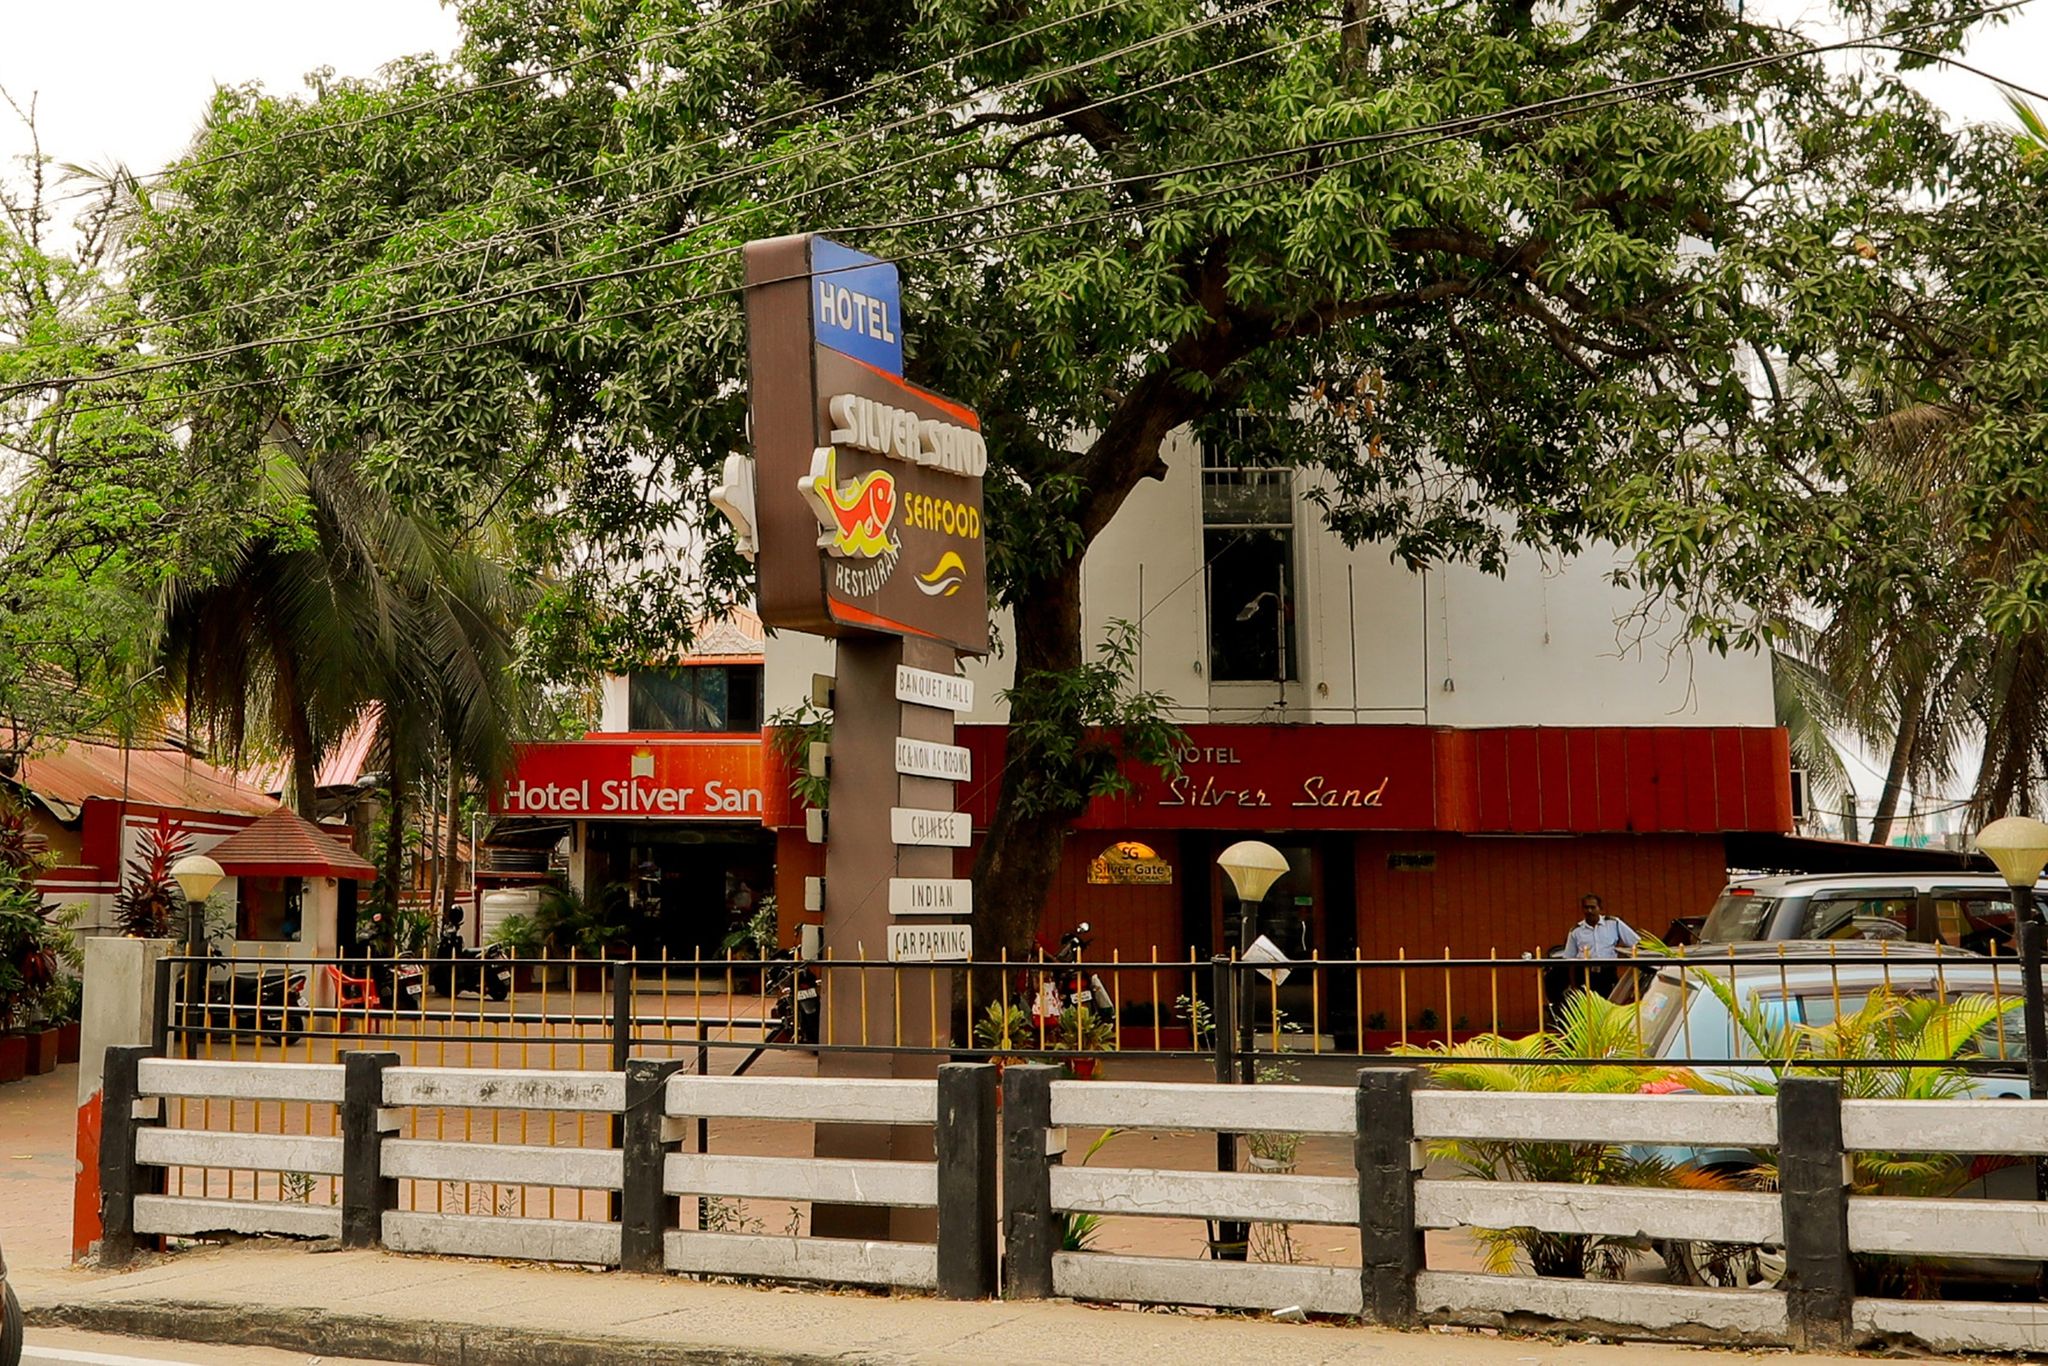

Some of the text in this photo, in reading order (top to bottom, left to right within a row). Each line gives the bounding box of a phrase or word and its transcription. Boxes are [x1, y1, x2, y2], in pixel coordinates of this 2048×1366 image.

[818, 281, 895, 344] HOTEL
[831, 393, 987, 477] SILVER SAND
[904, 491, 980, 540] SEAFOOD
[835, 528, 902, 597] RESTAURANT
[899, 671, 969, 704] BANQUET HALL
[503, 779, 590, 811] Hotel
[601, 780, 694, 812] Silver
[1159, 775, 1389, 807] Silver Sand
[911, 815, 955, 840] CHINESE
[1095, 862, 1165, 875] Silver Gate
[911, 885, 953, 908] INDIAN
[895, 931, 966, 955] CAR PARKING
